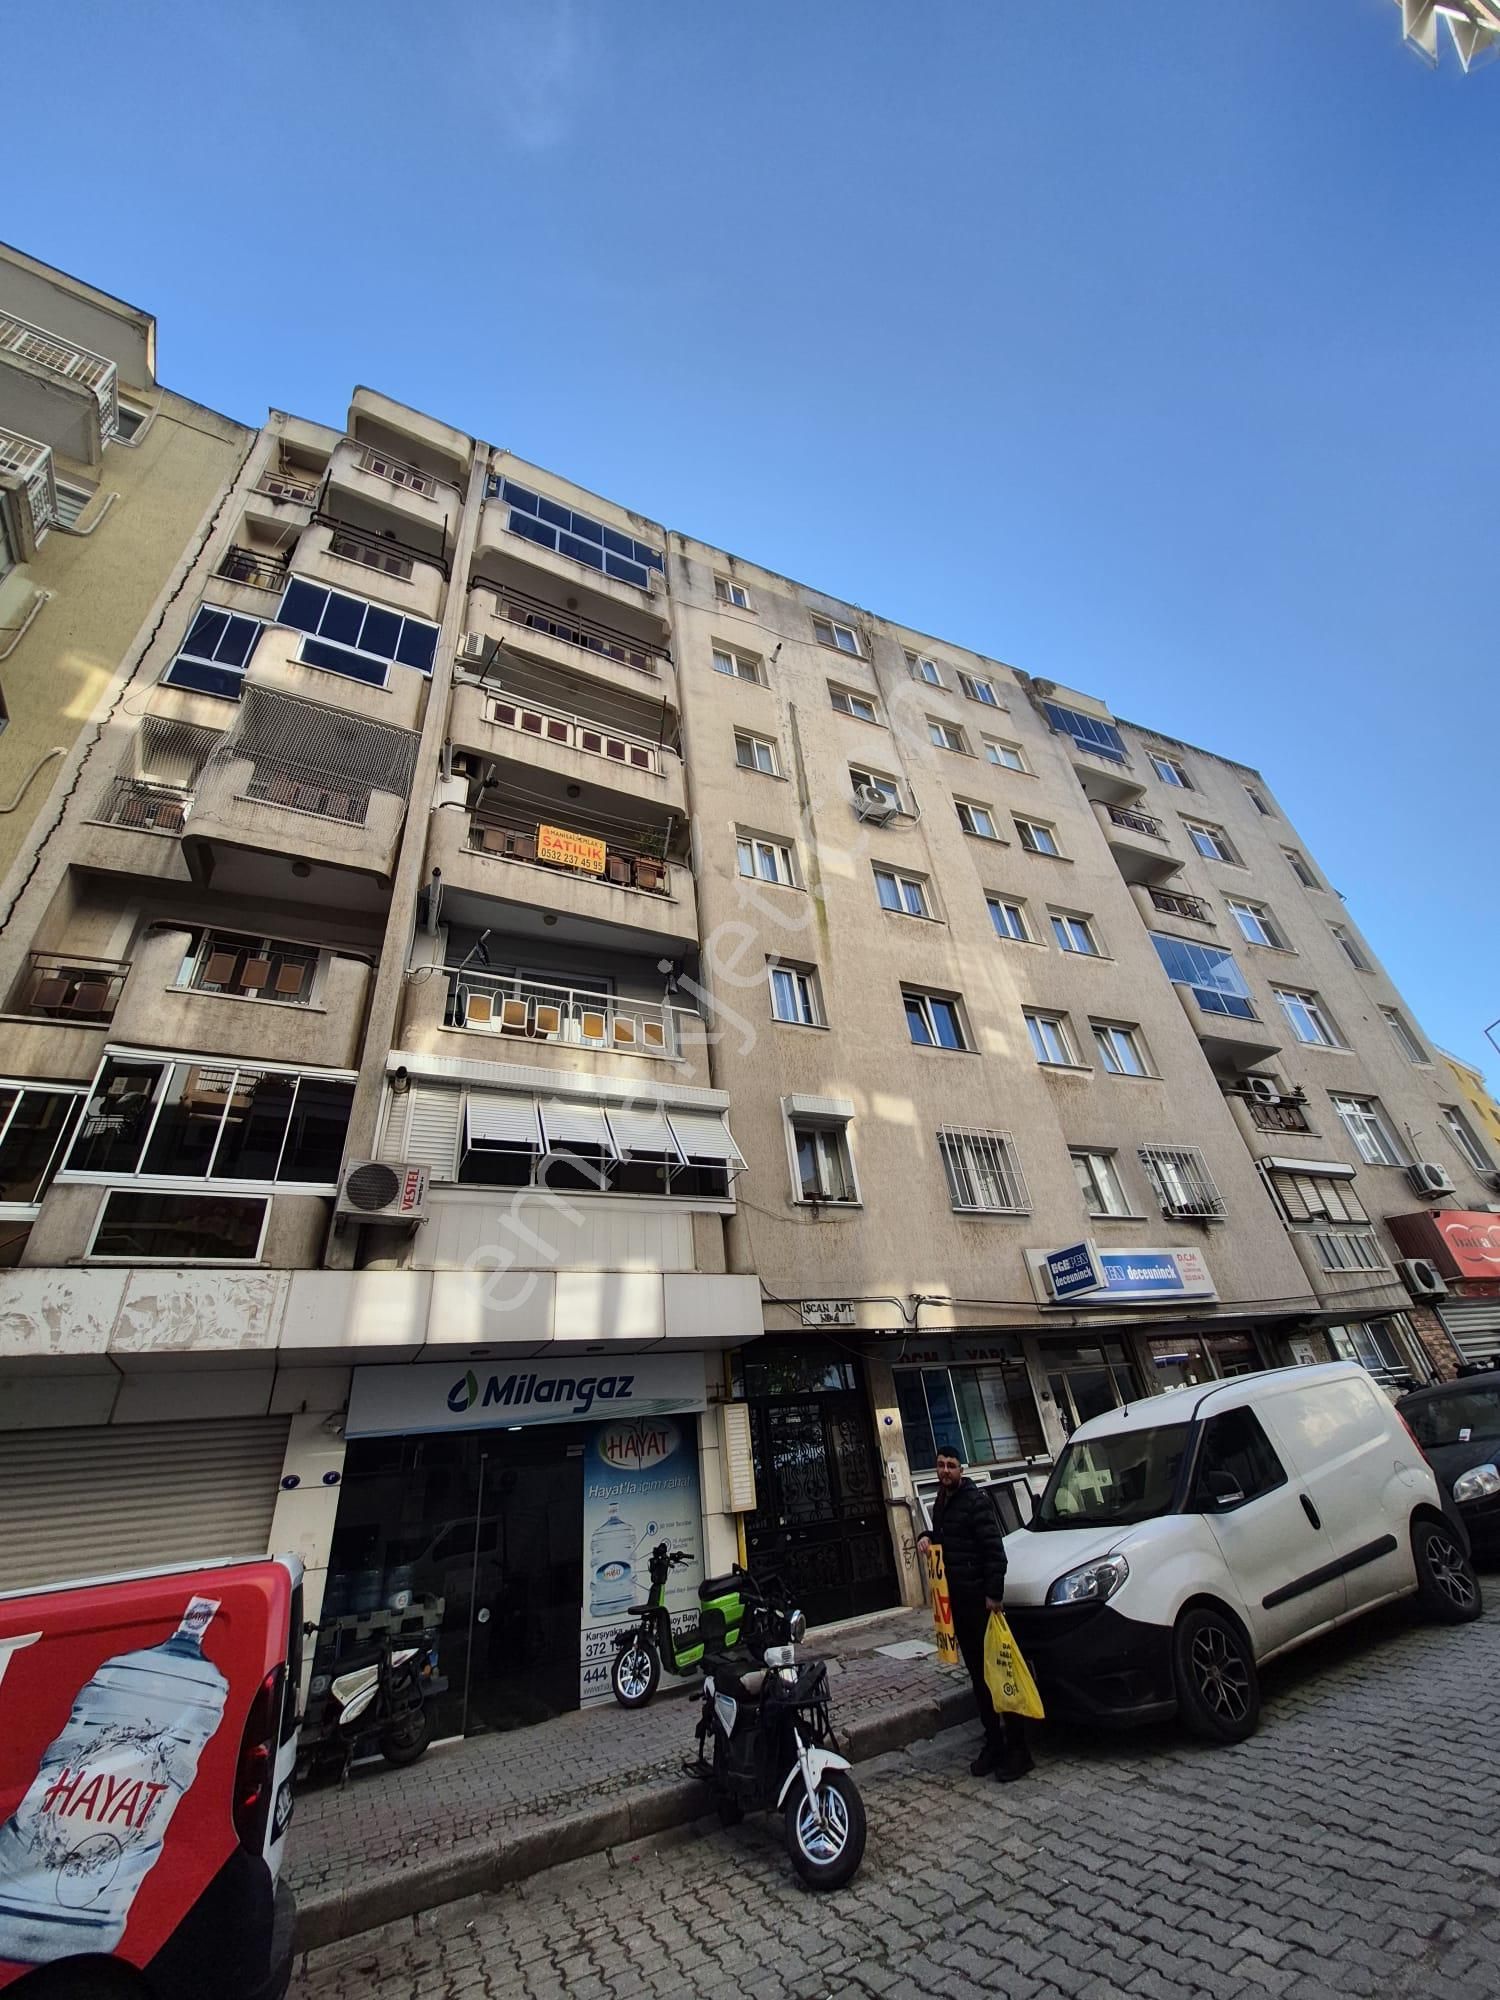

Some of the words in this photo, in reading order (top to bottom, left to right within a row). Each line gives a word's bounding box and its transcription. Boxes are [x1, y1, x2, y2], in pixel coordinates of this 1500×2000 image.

[541, 847, 561, 860] 0532
[563, 853, 579, 865] 237
[581, 857, 591, 868] 45
[593, 861, 603, 871] 95
[543, 836, 602, 860] SATILIK
[401, 1168, 420, 1211] VESTEL
[1050, 1252, 1089, 1274] EGEPEN
[1127, 1264, 1177, 1281] deceuninck
[1054, 1266, 1093, 1288] deceuninck
[481, 1374, 635, 1414] Milangaz
[607, 1431, 669, 1459] HAYAT
[588, 1480, 637, 1501] Hayat'la
[585, 1627, 623, 1642] Karşıyaka
[585, 1642, 607, 1657] 372
[583, 1665, 609, 1683] 444
[42, 1767, 169, 1829] HAYAT
